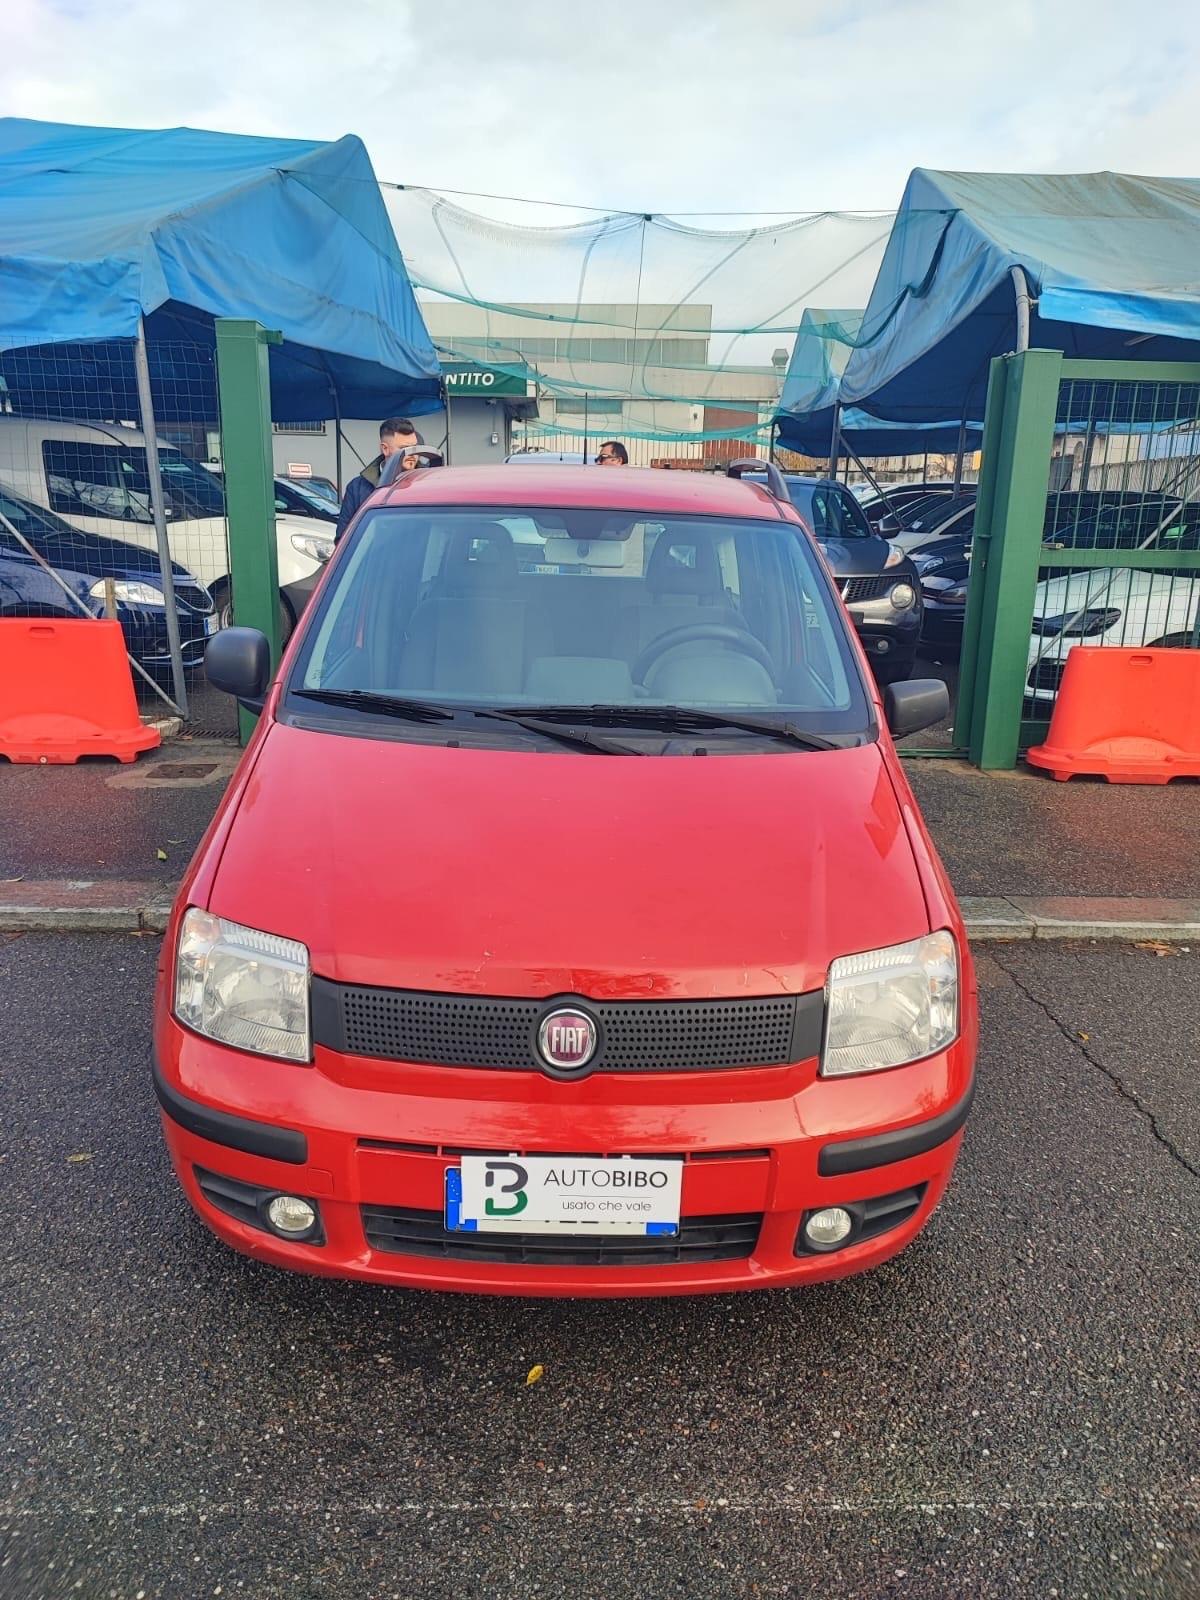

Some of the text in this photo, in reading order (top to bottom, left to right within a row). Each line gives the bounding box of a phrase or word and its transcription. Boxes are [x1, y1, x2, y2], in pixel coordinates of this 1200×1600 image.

[551, 1026, 586, 1053] FIAT
[543, 1168, 669, 1188] AUTOBIBO
[562, 1200, 652, 1212] usato che vale
